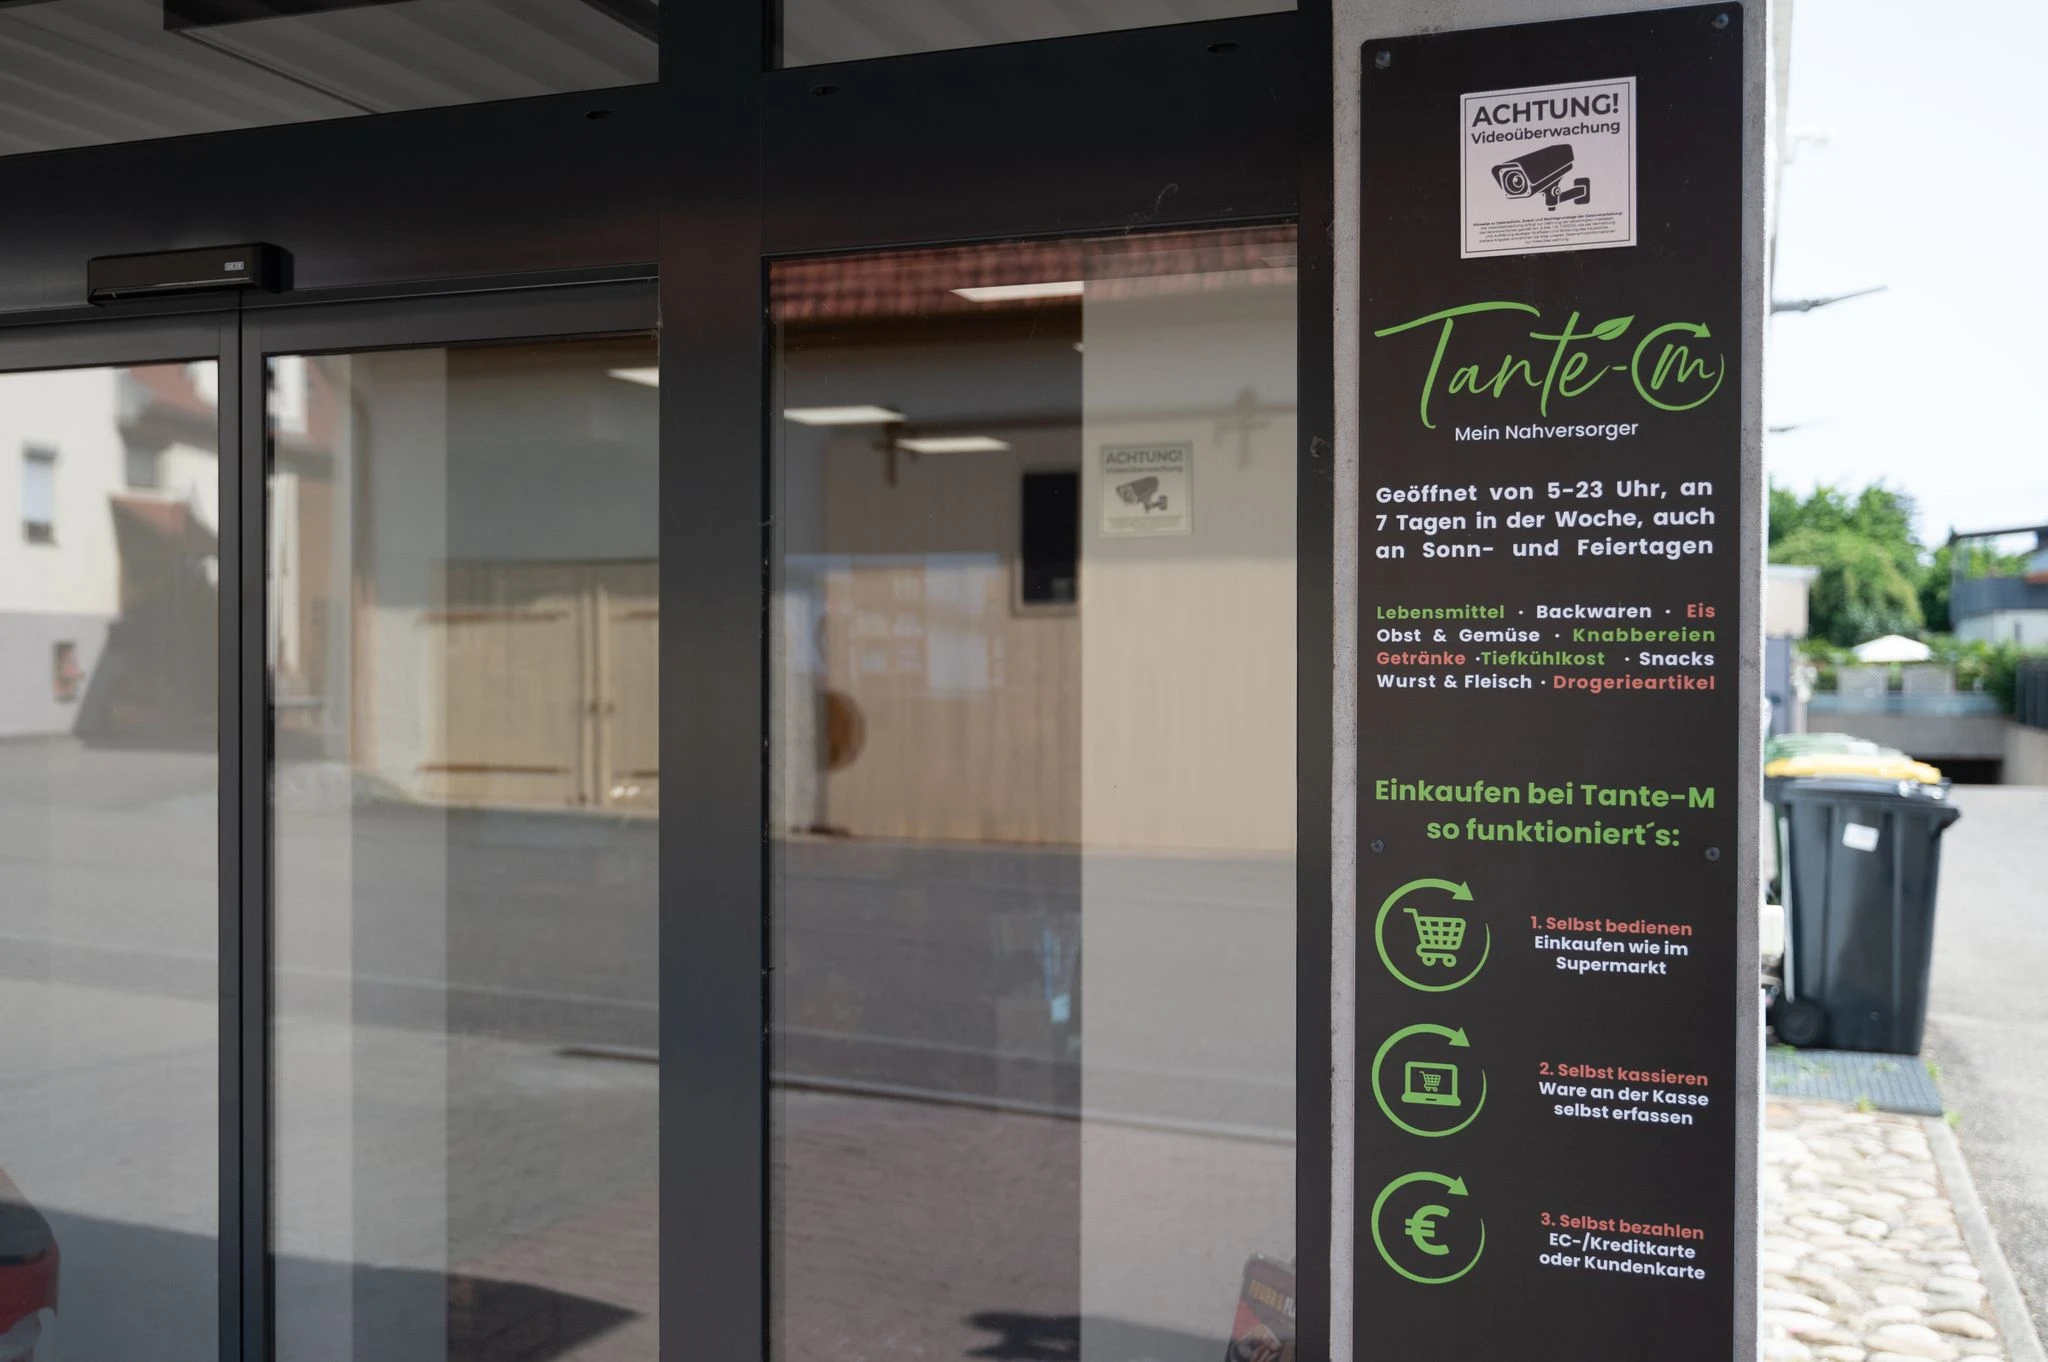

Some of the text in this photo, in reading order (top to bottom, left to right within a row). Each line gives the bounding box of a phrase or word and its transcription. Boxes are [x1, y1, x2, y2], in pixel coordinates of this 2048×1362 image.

[1471, 92, 1619, 128] ACHTUNG!
[1470, 121, 1621, 145] Videoüberwachung
[1455, 423, 1639, 442] Mein Nahversorger
[1106, 450, 1183, 464] ACHTUNG!
[1375, 479, 1713, 504] Geöffnet von 5-23 Uhr, an
[1375, 506, 1715, 536] 7 Tagen in der Woche, auch
[1375, 536, 1713, 561] an Sonn- und Feiertagen
[1376, 602, 1716, 620] Lebensmittel Backwaren Eis
[1376, 626, 1715, 643] Obst & Gemüse Knabbereien
[1376, 650, 1466, 666] Getränke
[1639, 650, 1715, 666] Snacks
[1376, 673, 1715, 694] Wurst & Fleisch Drogerieartikel
[1375, 777, 1715, 809] Einkaufen bei Tante-M
[1426, 822, 1460, 840] so
[1530, 915, 1693, 937] 1. Selbst bedienen
[1534, 934, 1689, 956] Einkaufen wie im
[1556, 956, 1667, 975] Supermarkt
[1539, 1061, 1709, 1087] 2. Selbst kassieren
[1538, 1081, 1709, 1107] Ware an der Kasse
[1553, 1102, 1693, 1125] selbst erfassen
[1540, 1211, 1704, 1240] 3. Selbst bezahlen
[1549, 1233, 1696, 1258] EC-/Kreditkarte
[1539, 1252, 1706, 1280] oder Kundenkarte
